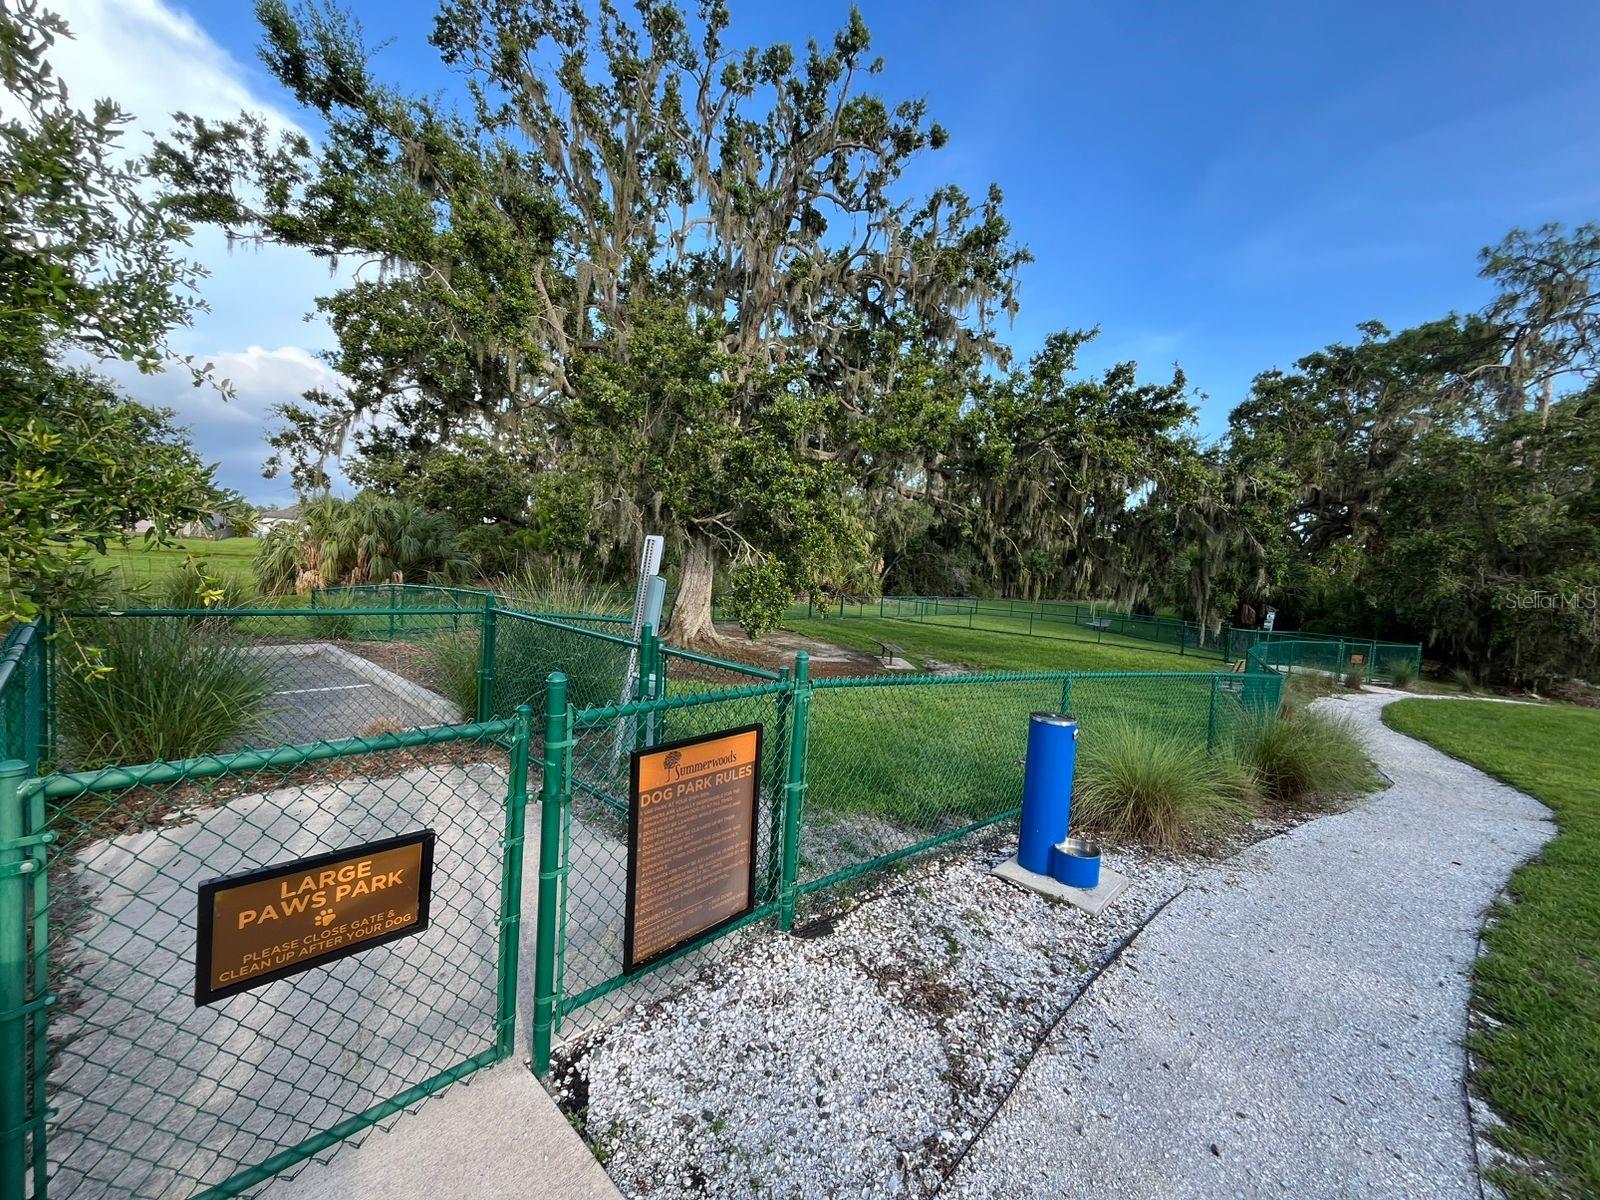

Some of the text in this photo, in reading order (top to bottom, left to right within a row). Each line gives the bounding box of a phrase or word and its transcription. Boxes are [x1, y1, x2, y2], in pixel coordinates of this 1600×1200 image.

[640, 765, 753, 808] DOG PARK RULES
[674, 750, 737, 781] Summerwoods
[237, 869, 404, 930] PAWS PARK
[281, 861, 372, 899] LARGE
[219, 913, 412, 982] CLEAN UP AFTER YOUR DOG
[243, 910, 395, 963] PLEASE CLOSE GATE &
